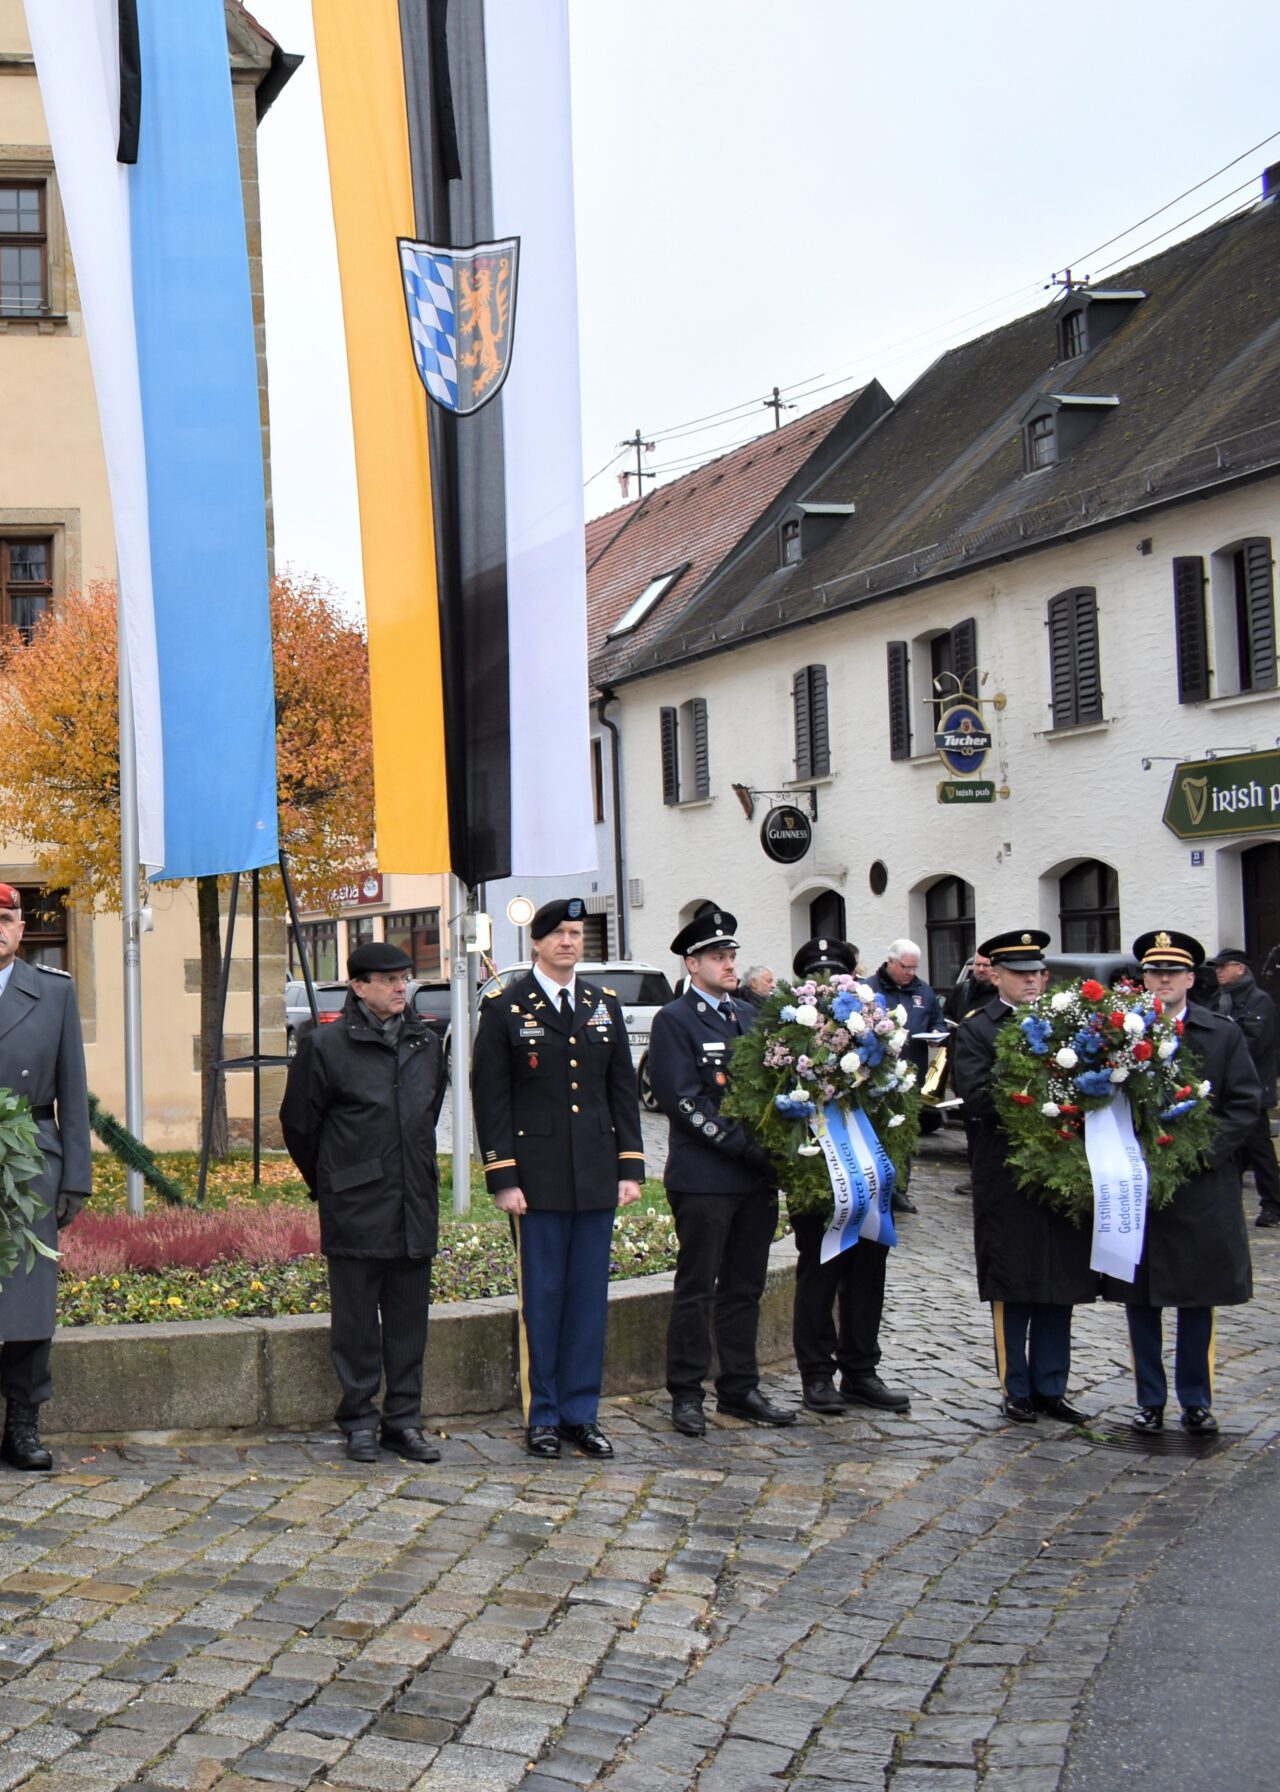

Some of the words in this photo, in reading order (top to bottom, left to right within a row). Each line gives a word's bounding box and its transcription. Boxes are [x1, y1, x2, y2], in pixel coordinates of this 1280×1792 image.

[944, 735, 987, 746] Tucher
[975, 788, 990, 797] pub
[769, 829, 808, 839] GUINNESS
[825, 1140, 849, 1205] Gedenken
[840, 1142, 858, 1177] Toten
[863, 1166, 877, 1200] Stadt
[851, 1181, 866, 1226] unserer
[1099, 1184, 1111, 1220] stillem
[1118, 1180, 1130, 1234] Gedenken
[830, 1207, 848, 1232] Zum
[1098, 1223, 1110, 1233] In
